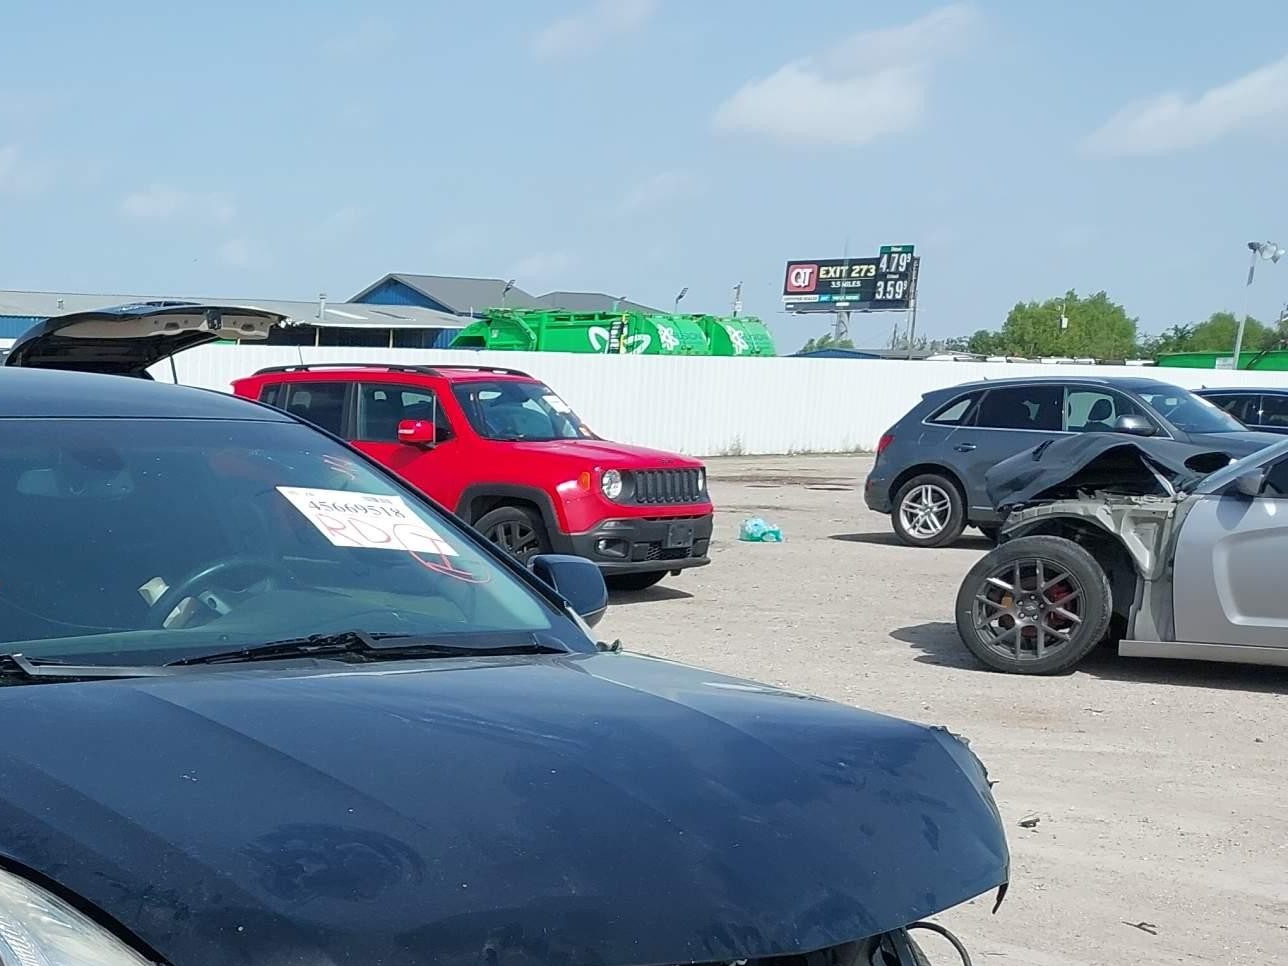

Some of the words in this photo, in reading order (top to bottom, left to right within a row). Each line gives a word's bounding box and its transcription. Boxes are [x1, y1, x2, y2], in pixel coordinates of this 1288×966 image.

[791, 268, 813, 287] QT
[819, 266, 848, 279] EXIT
[851, 264, 876, 277] 273
[308, 500, 406, 519] 45669518
